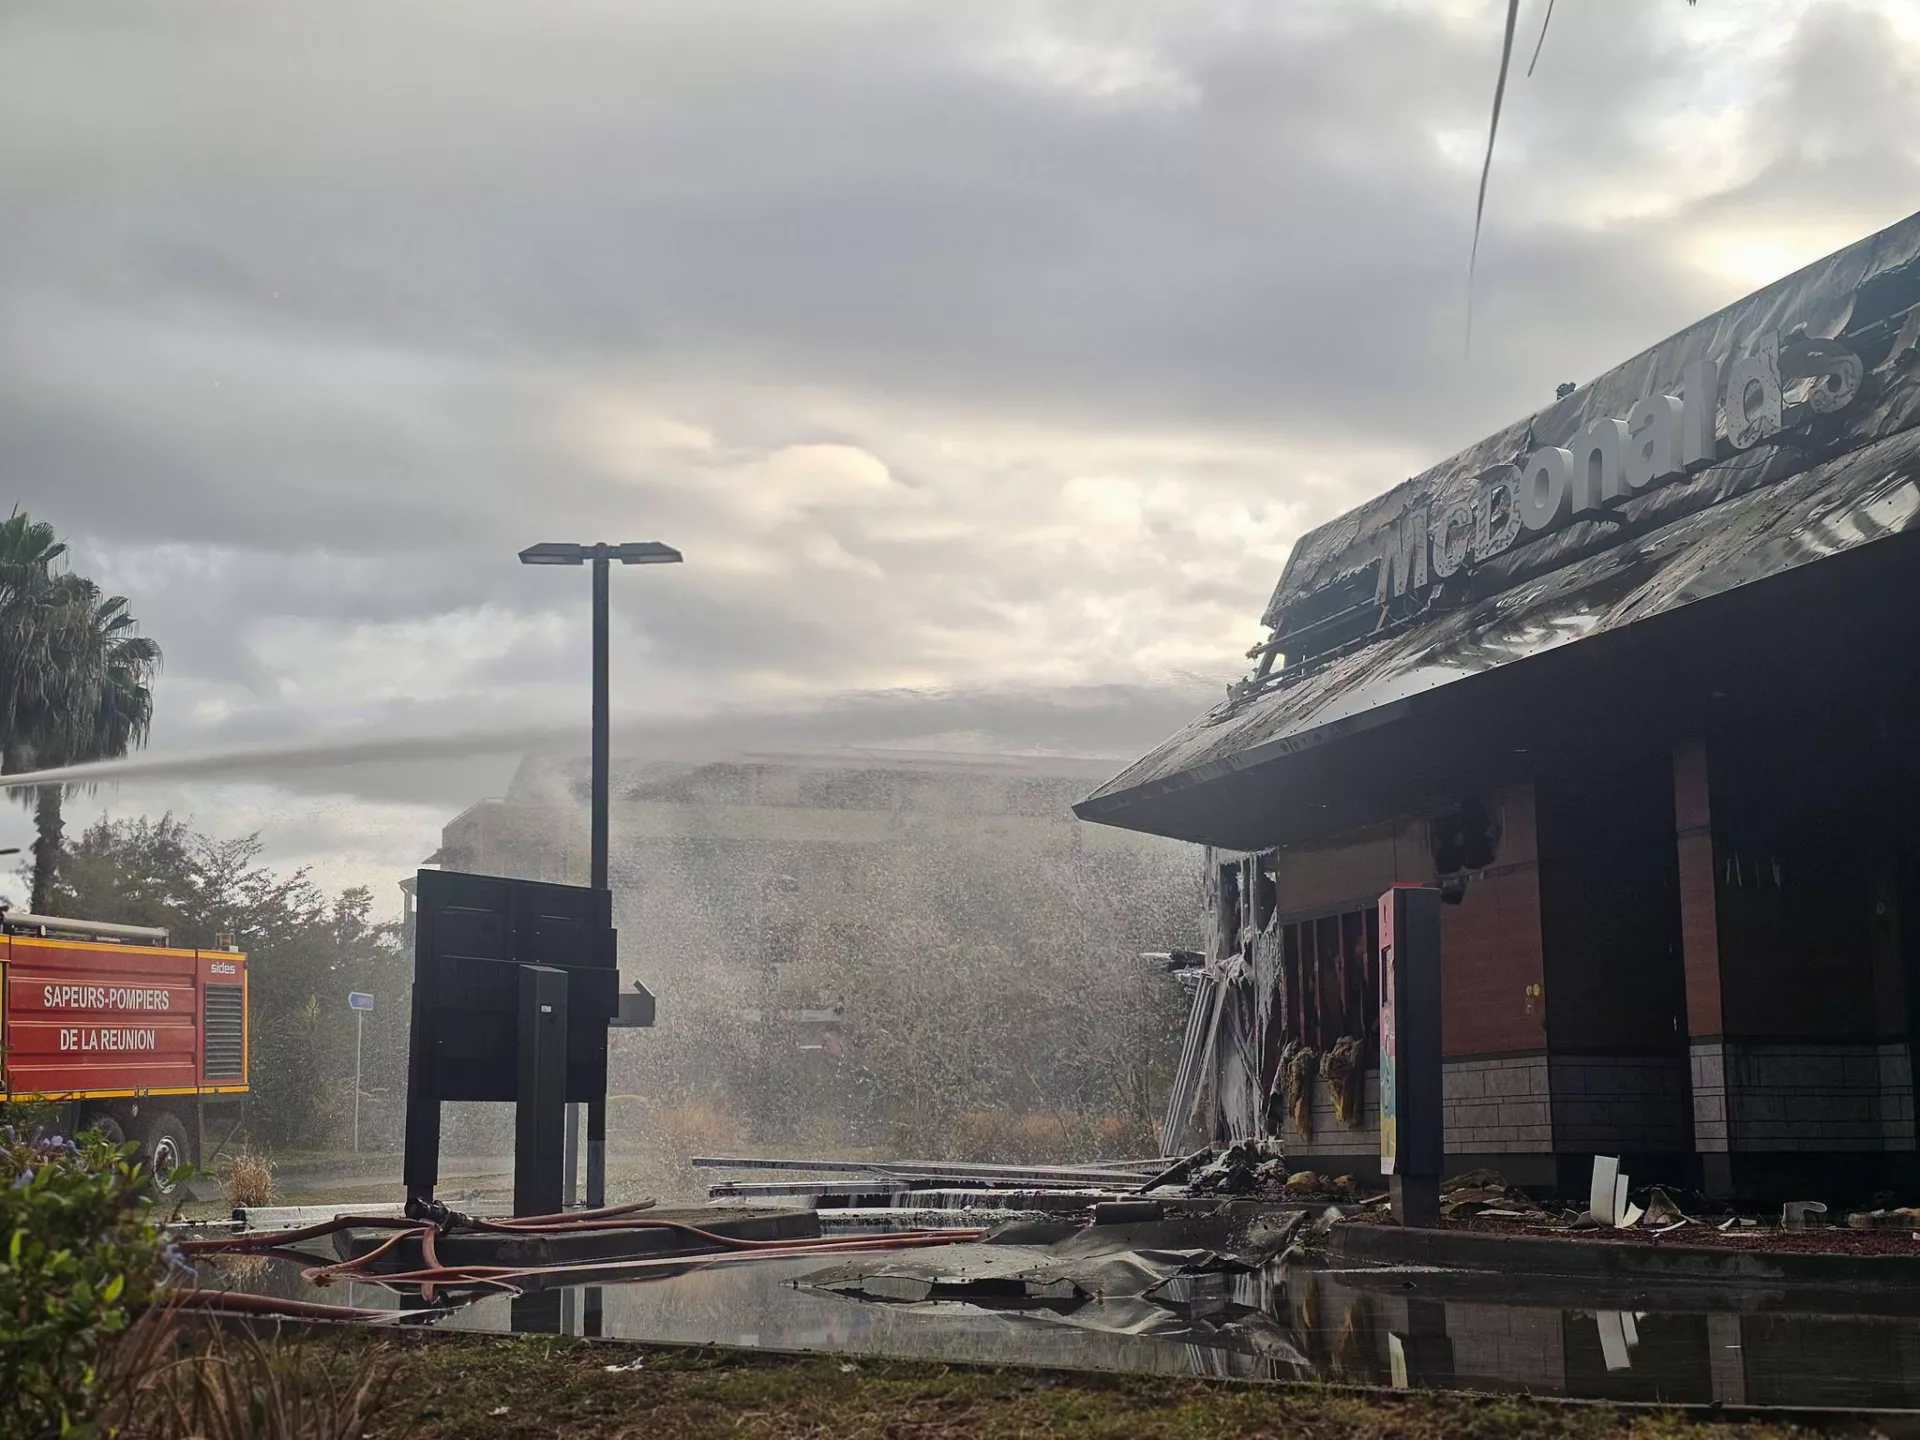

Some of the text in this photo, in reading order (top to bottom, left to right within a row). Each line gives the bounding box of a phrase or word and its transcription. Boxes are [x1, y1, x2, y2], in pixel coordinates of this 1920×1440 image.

[211, 962, 236, 975] sides
[44, 985, 169, 1010] SAPEURS-POMPIERS
[60, 1029, 155, 1050] DE LA REUNION
